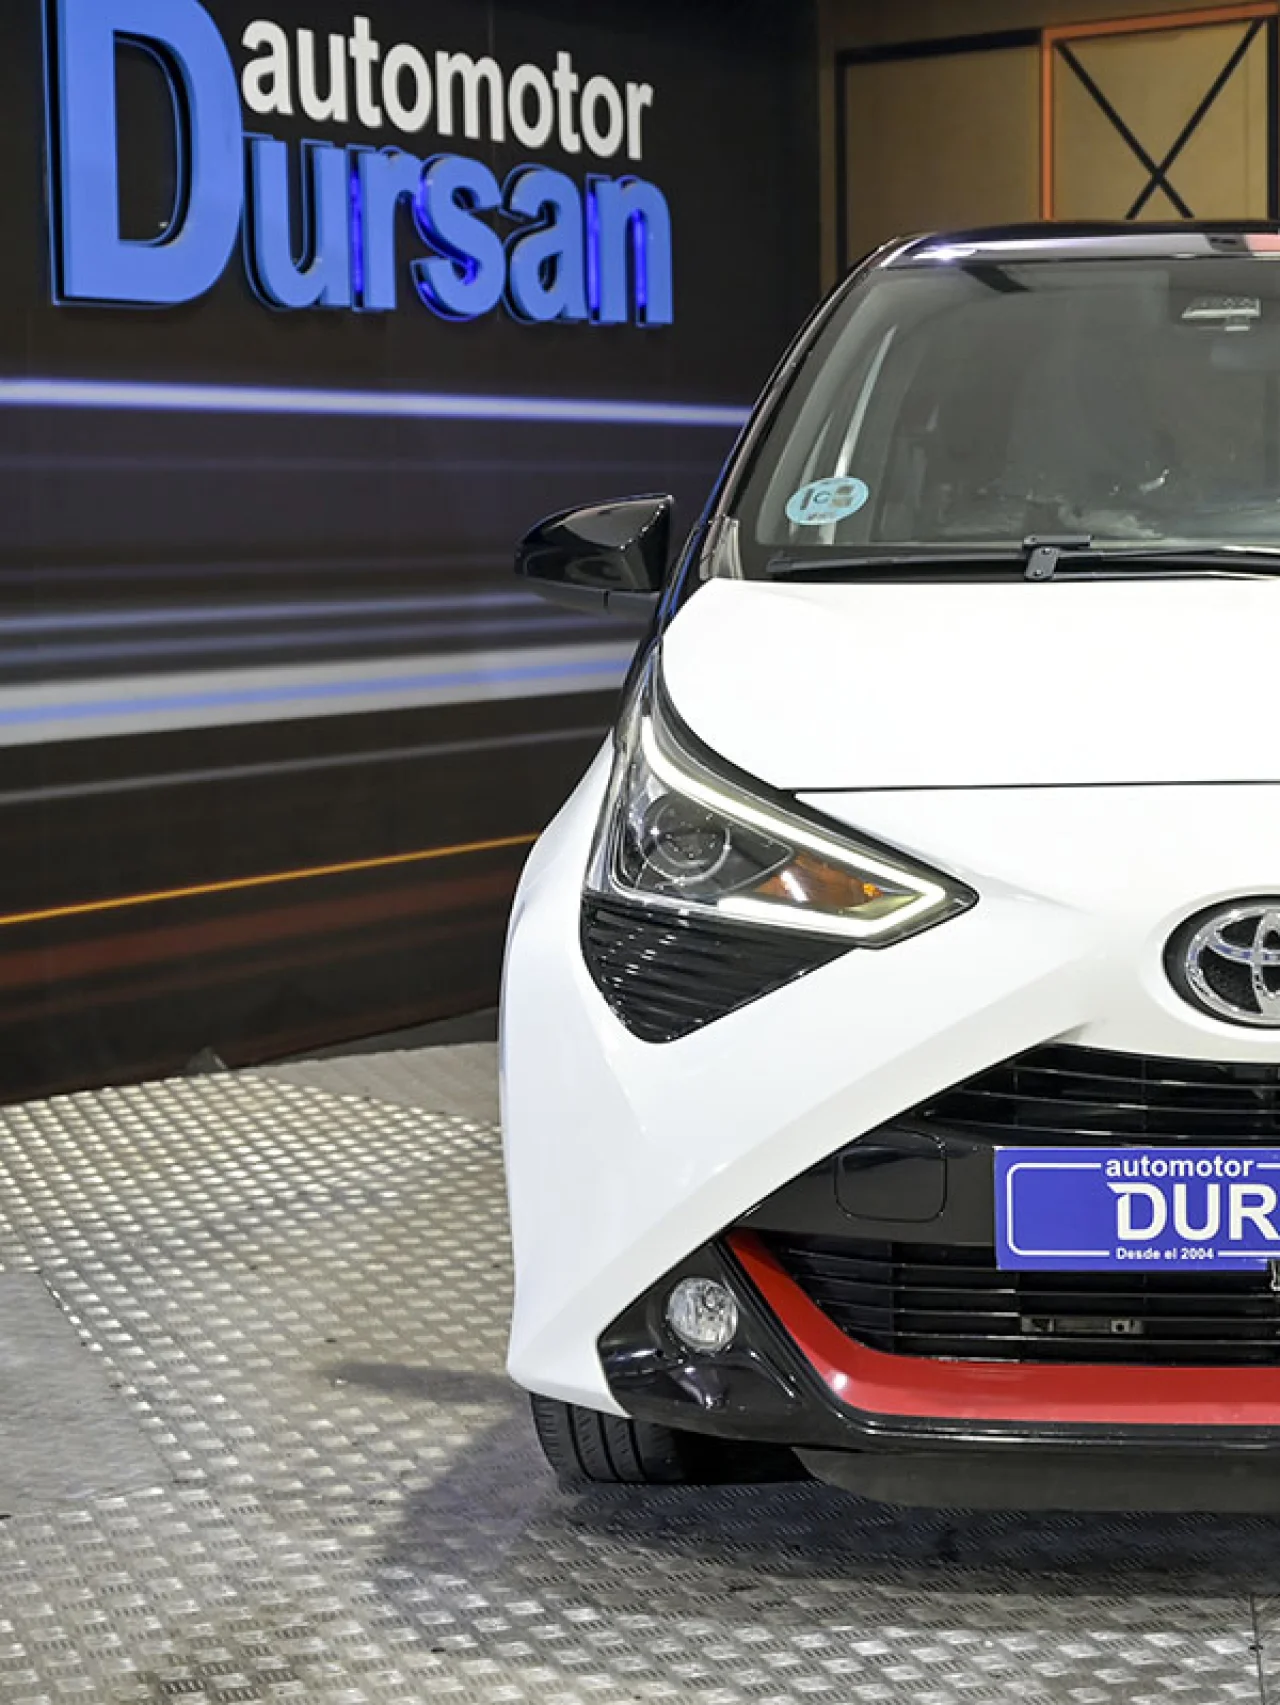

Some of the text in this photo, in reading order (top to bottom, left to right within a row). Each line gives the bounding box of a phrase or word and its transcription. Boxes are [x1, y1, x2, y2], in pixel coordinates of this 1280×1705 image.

[241, 15, 653, 160] automotor
[45, 0, 673, 327] Dursan
[1105, 1155, 1254, 1177] automotor
[1116, 1247, 1215, 1260] Desde el 2004
